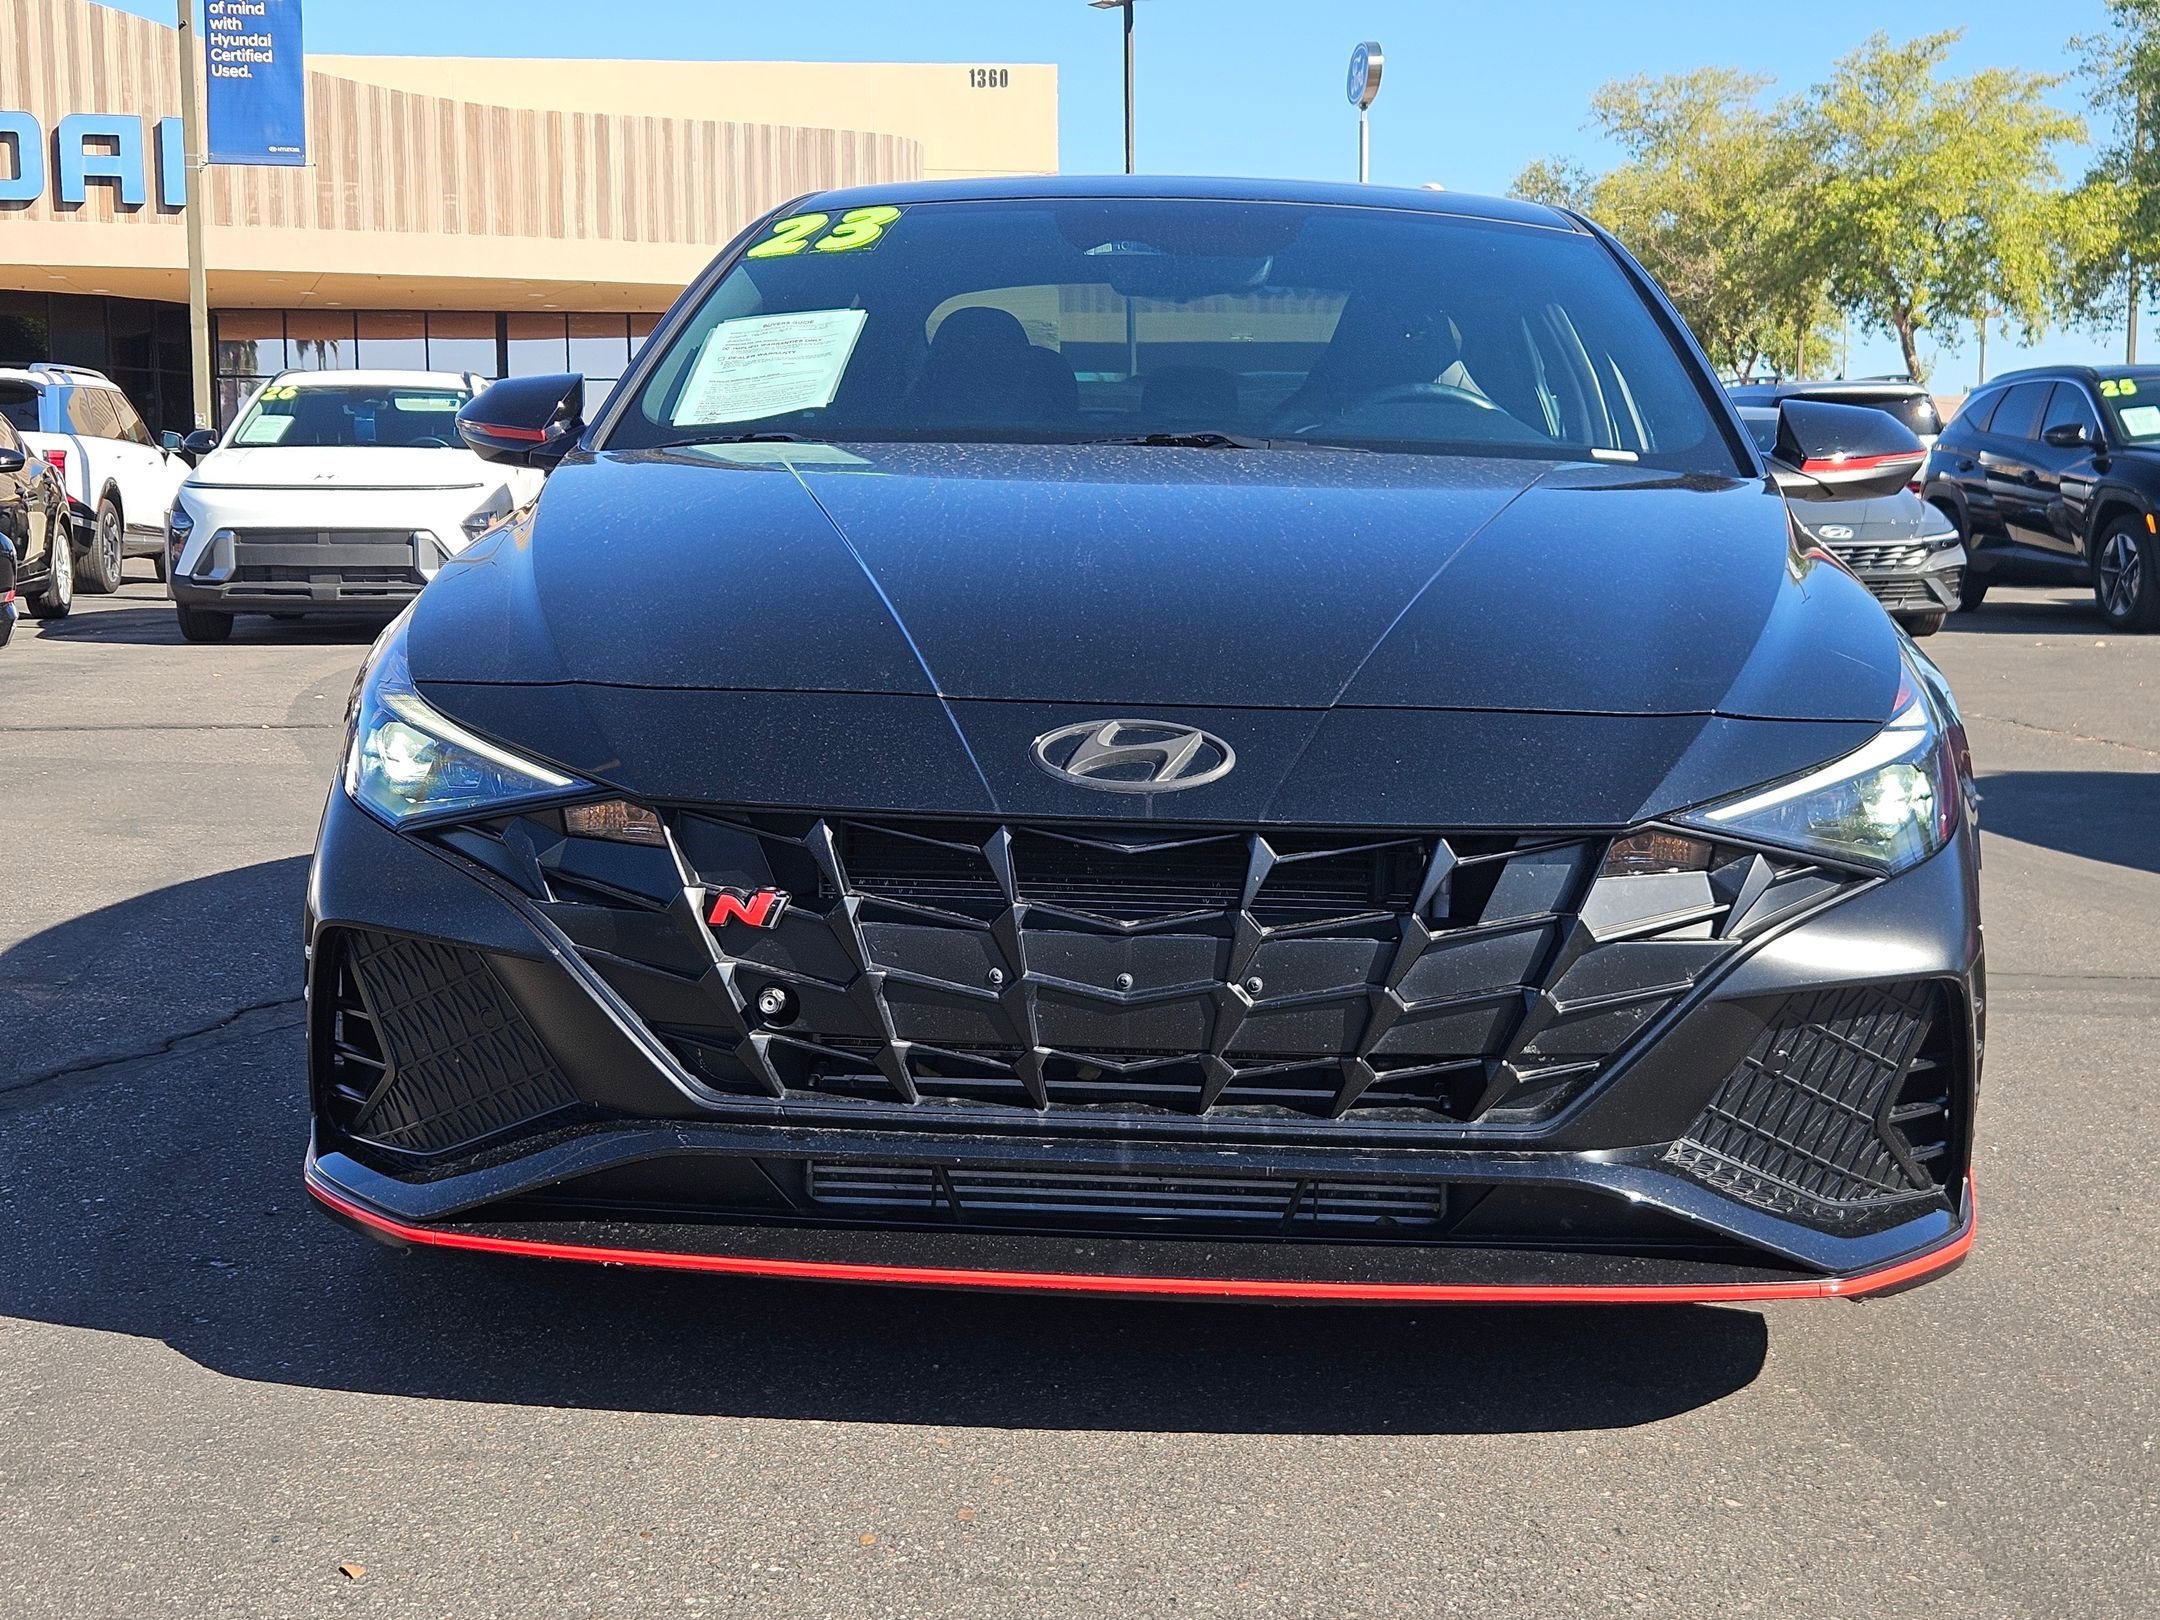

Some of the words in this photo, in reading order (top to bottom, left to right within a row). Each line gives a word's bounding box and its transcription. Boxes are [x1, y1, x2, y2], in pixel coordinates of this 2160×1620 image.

[209, 1, 225, 14] of
[227, 1, 265, 16] mind
[209, 16, 243, 30] with
[210, 32, 273, 48] Hyundai
[210, 48, 273, 63] Certified
[211, 64, 253, 78] Used.
[968, 68, 1008, 88] 1360
[746, 205, 902, 258] 23
[260, 385, 299, 400] 26
[2099, 378, 2137, 397] 25
